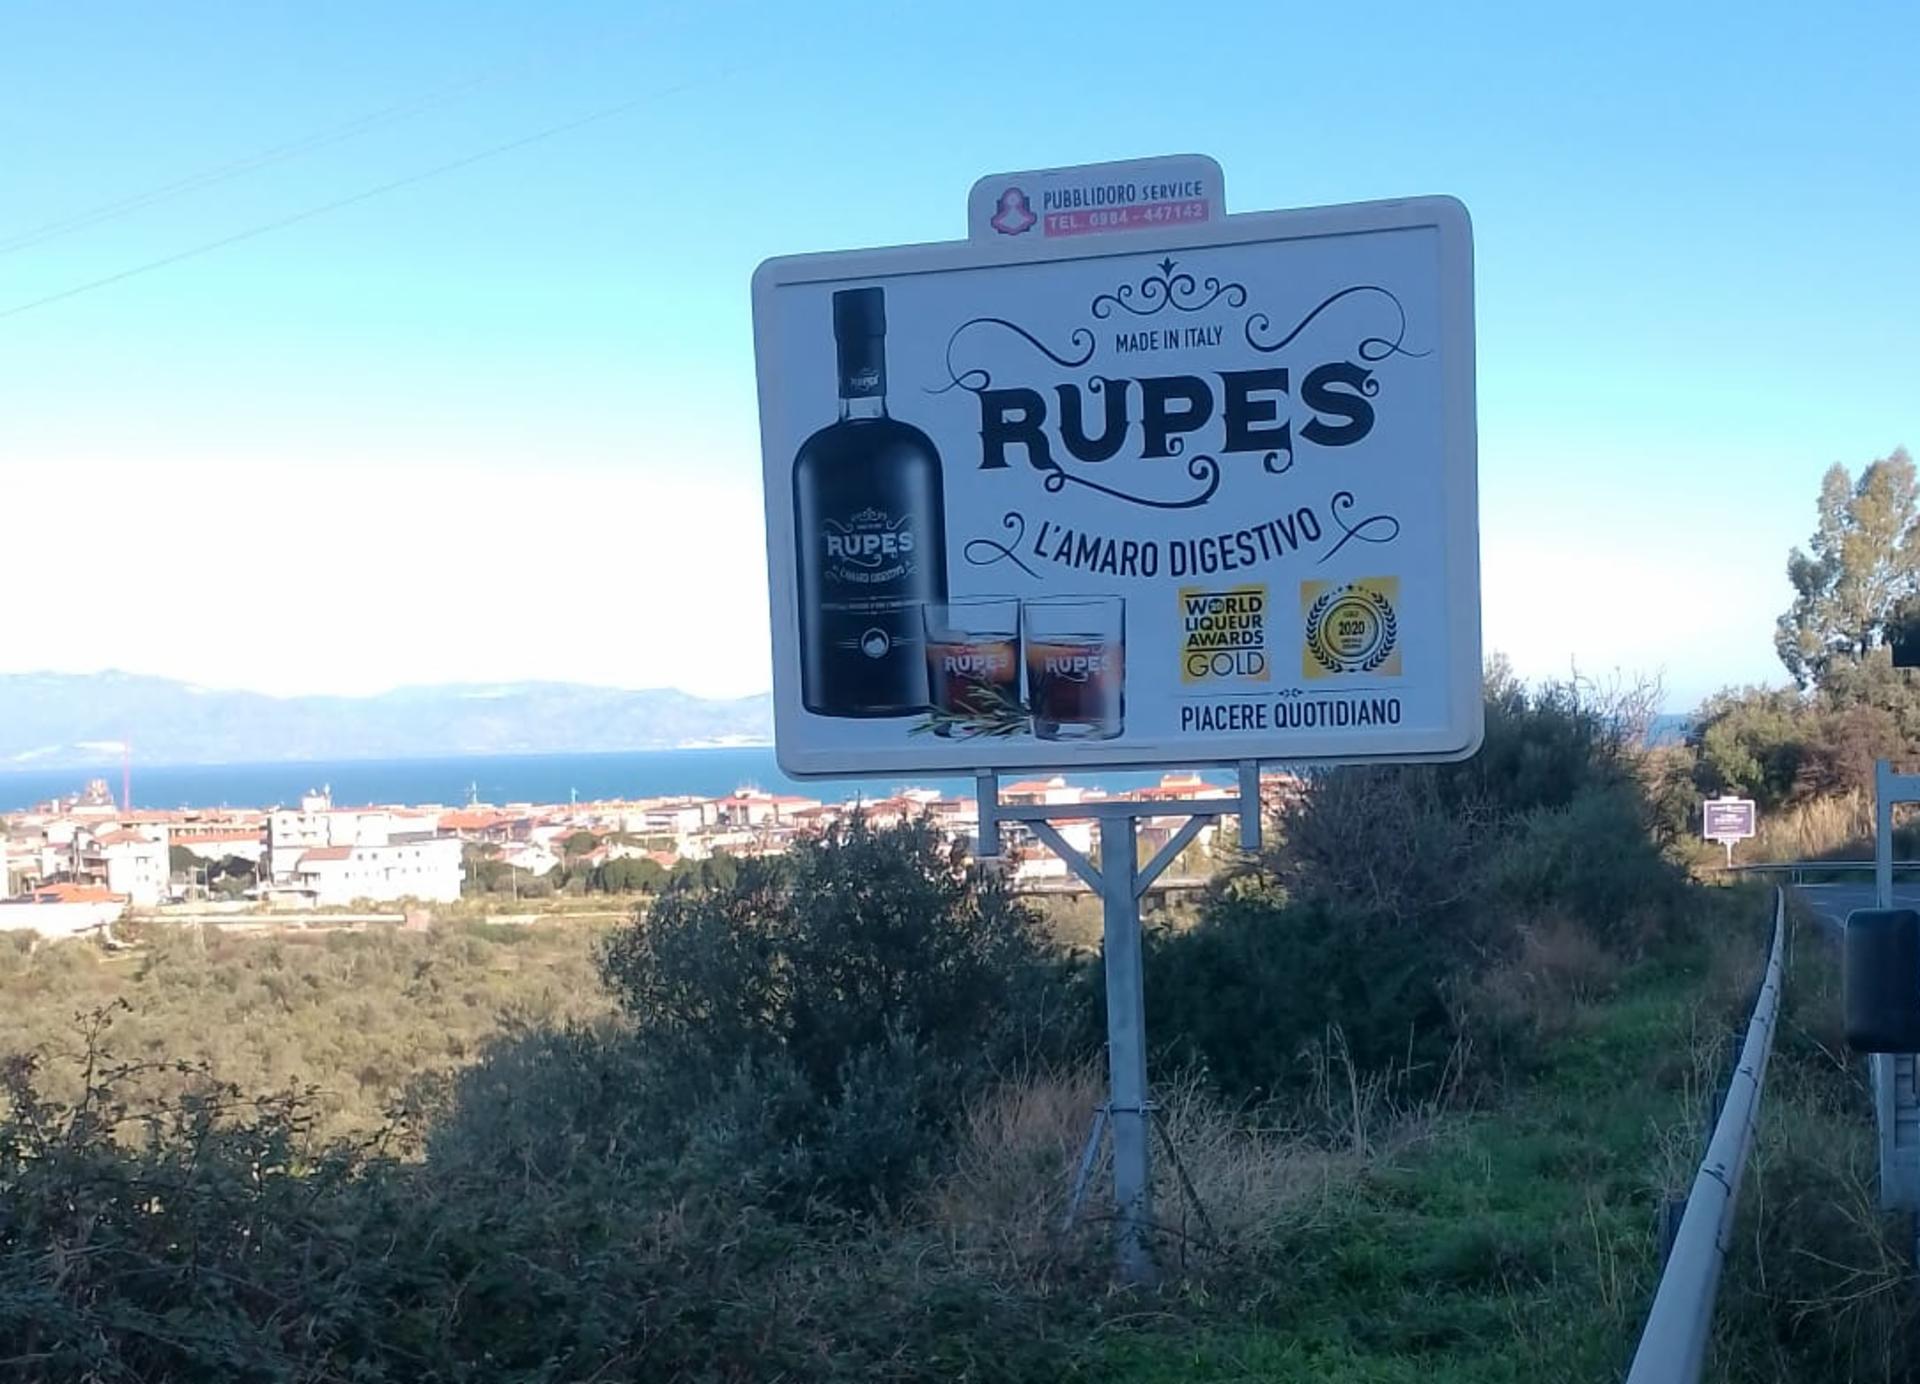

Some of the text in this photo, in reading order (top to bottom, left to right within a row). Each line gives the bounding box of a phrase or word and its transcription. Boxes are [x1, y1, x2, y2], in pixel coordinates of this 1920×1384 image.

[1044, 181, 1203, 210] PUBBLIDORO SERVICE
[1116, 325, 1222, 353] MADE IN ITALY
[977, 361, 1380, 473] RUPES
[827, 532, 914, 557] RUPES
[1033, 506, 1323, 578] L'AMARO DIGESTIVO
[1185, 596, 1263, 616] WORLD
[1185, 614, 1263, 632] LIQUEUR
[1338, 620, 1365, 636] 2020
[1187, 630, 1264, 647] AWARDS
[944, 654, 1009, 673] RUPES
[1046, 655, 1112, 673] RUPES
[1187, 651, 1265, 677] GOLD
[1181, 698, 1401, 731] PIACERE QUOTIDIANO
